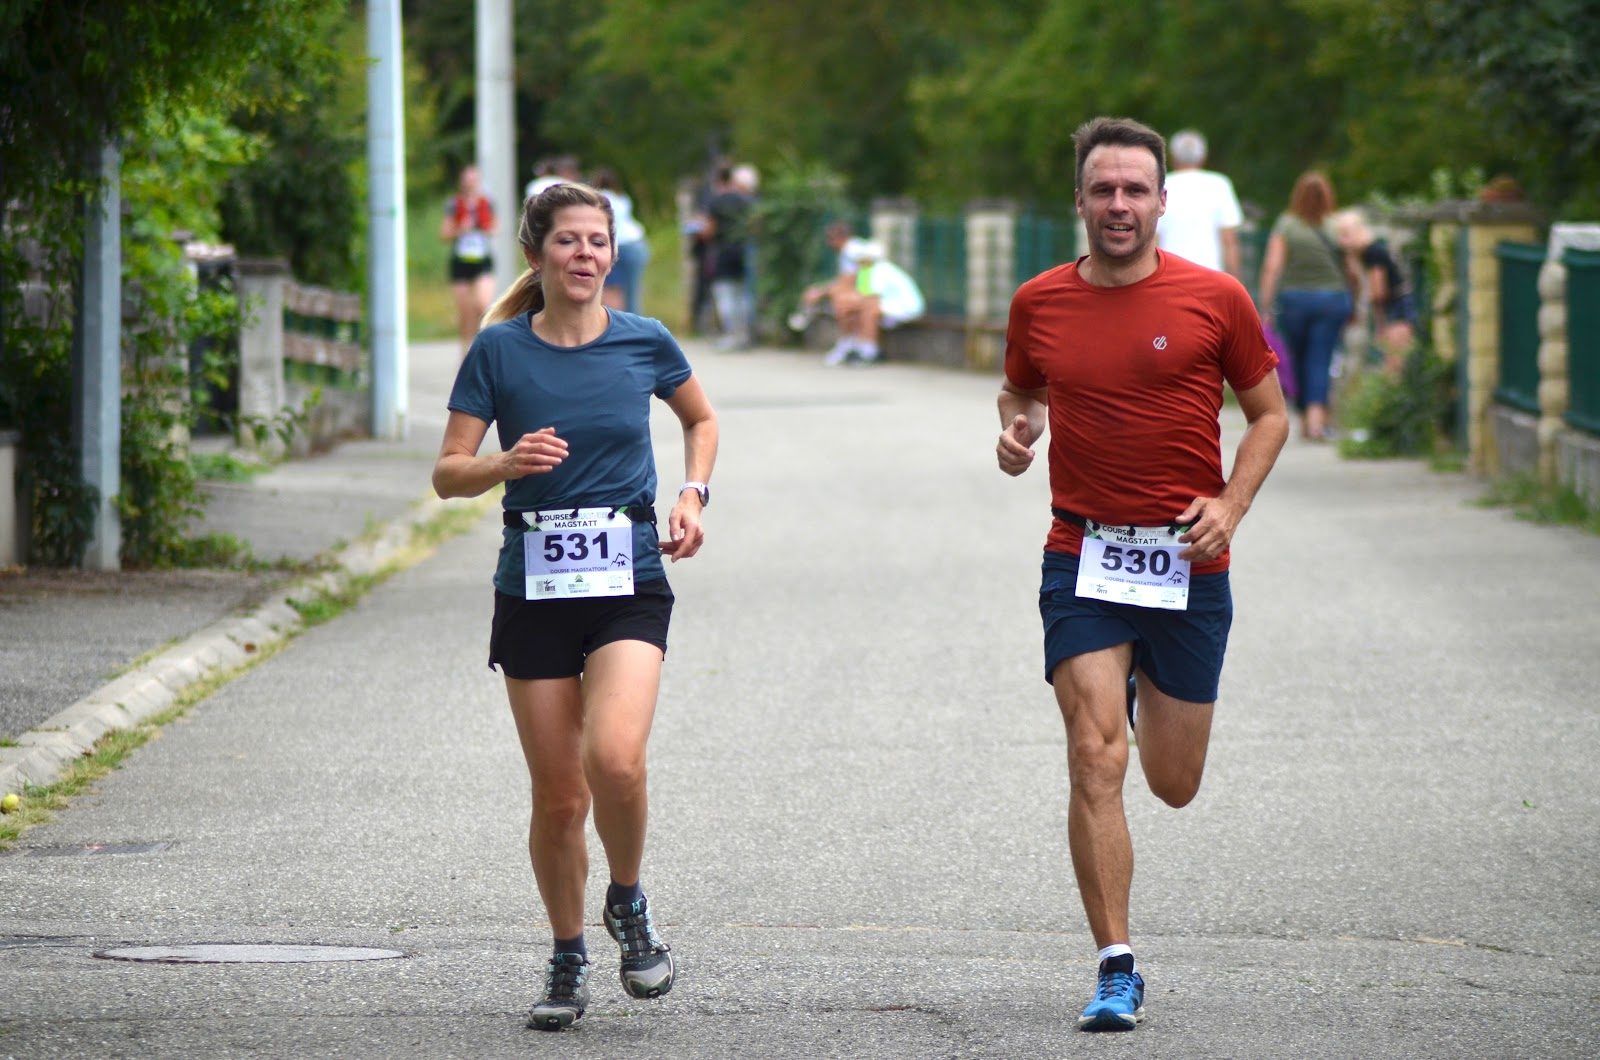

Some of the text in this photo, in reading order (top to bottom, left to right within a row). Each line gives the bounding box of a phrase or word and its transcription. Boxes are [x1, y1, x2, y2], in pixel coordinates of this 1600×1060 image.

[554, 520, 597, 528] MAGSTATT
[1116, 535, 1158, 545] MAGSTATT
[543, 531, 609, 562] 531
[1100, 545, 1171, 576] 530
[1104, 575, 1125, 583] COURSE
